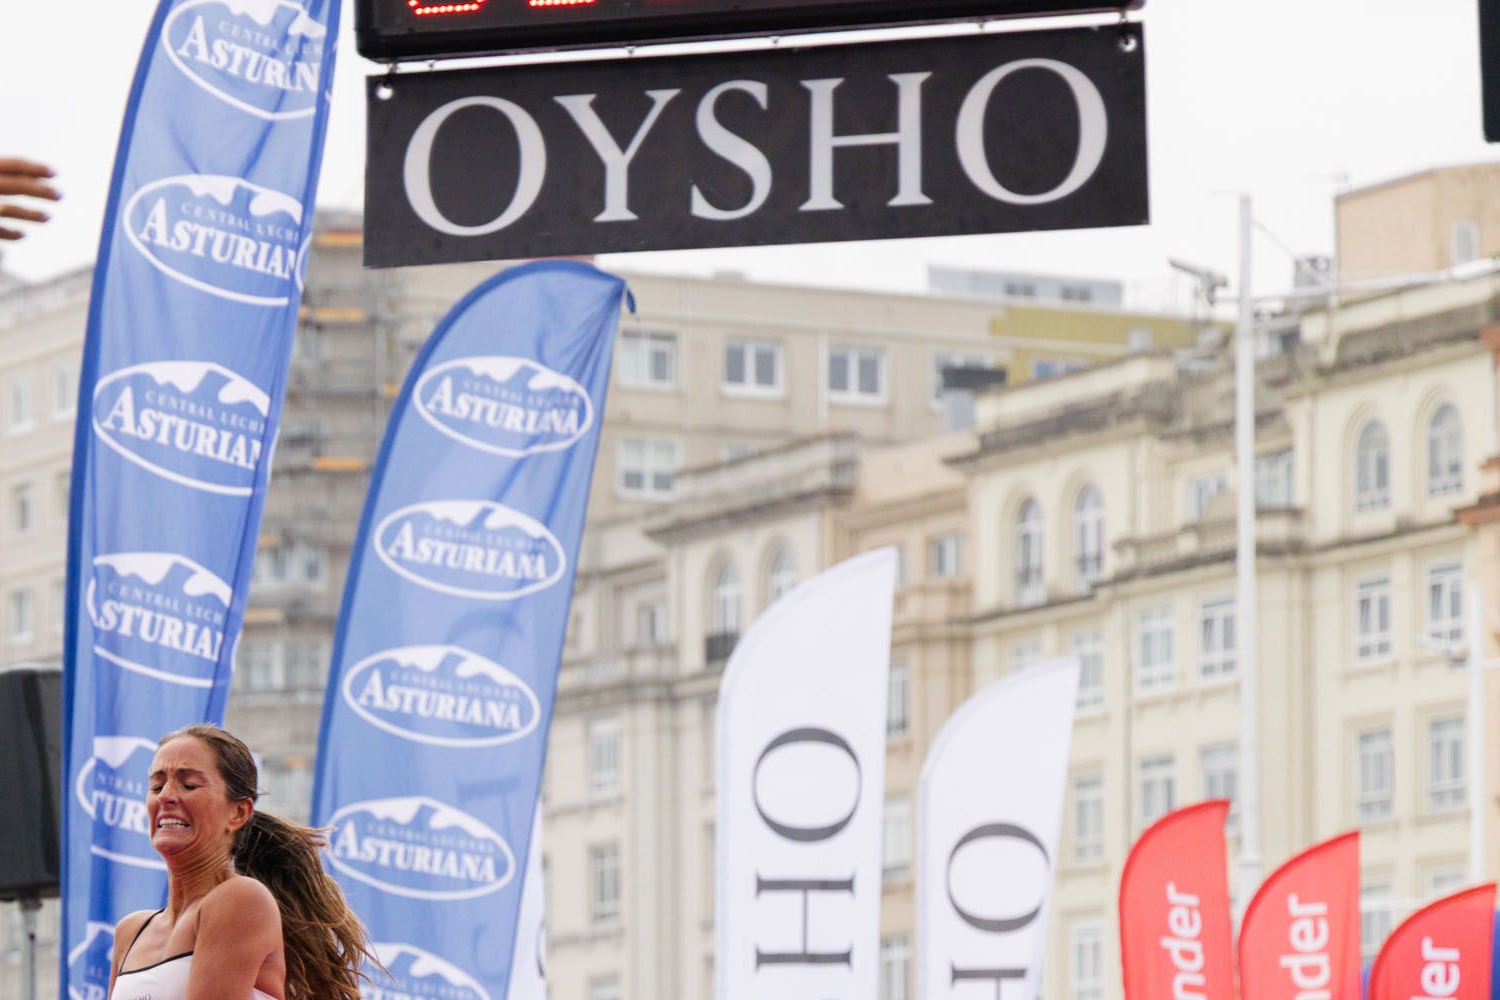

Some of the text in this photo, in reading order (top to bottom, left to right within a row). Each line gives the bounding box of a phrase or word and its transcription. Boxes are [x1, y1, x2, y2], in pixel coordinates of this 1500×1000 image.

[403, 57, 1109, 237] OYSHO
[426, 374, 579, 436] ASTURIANA
[387, 520, 549, 580] ASTURIANA
[357, 667, 523, 731] ASTURIANA
[333, 819, 498, 884] ASTURIANA
